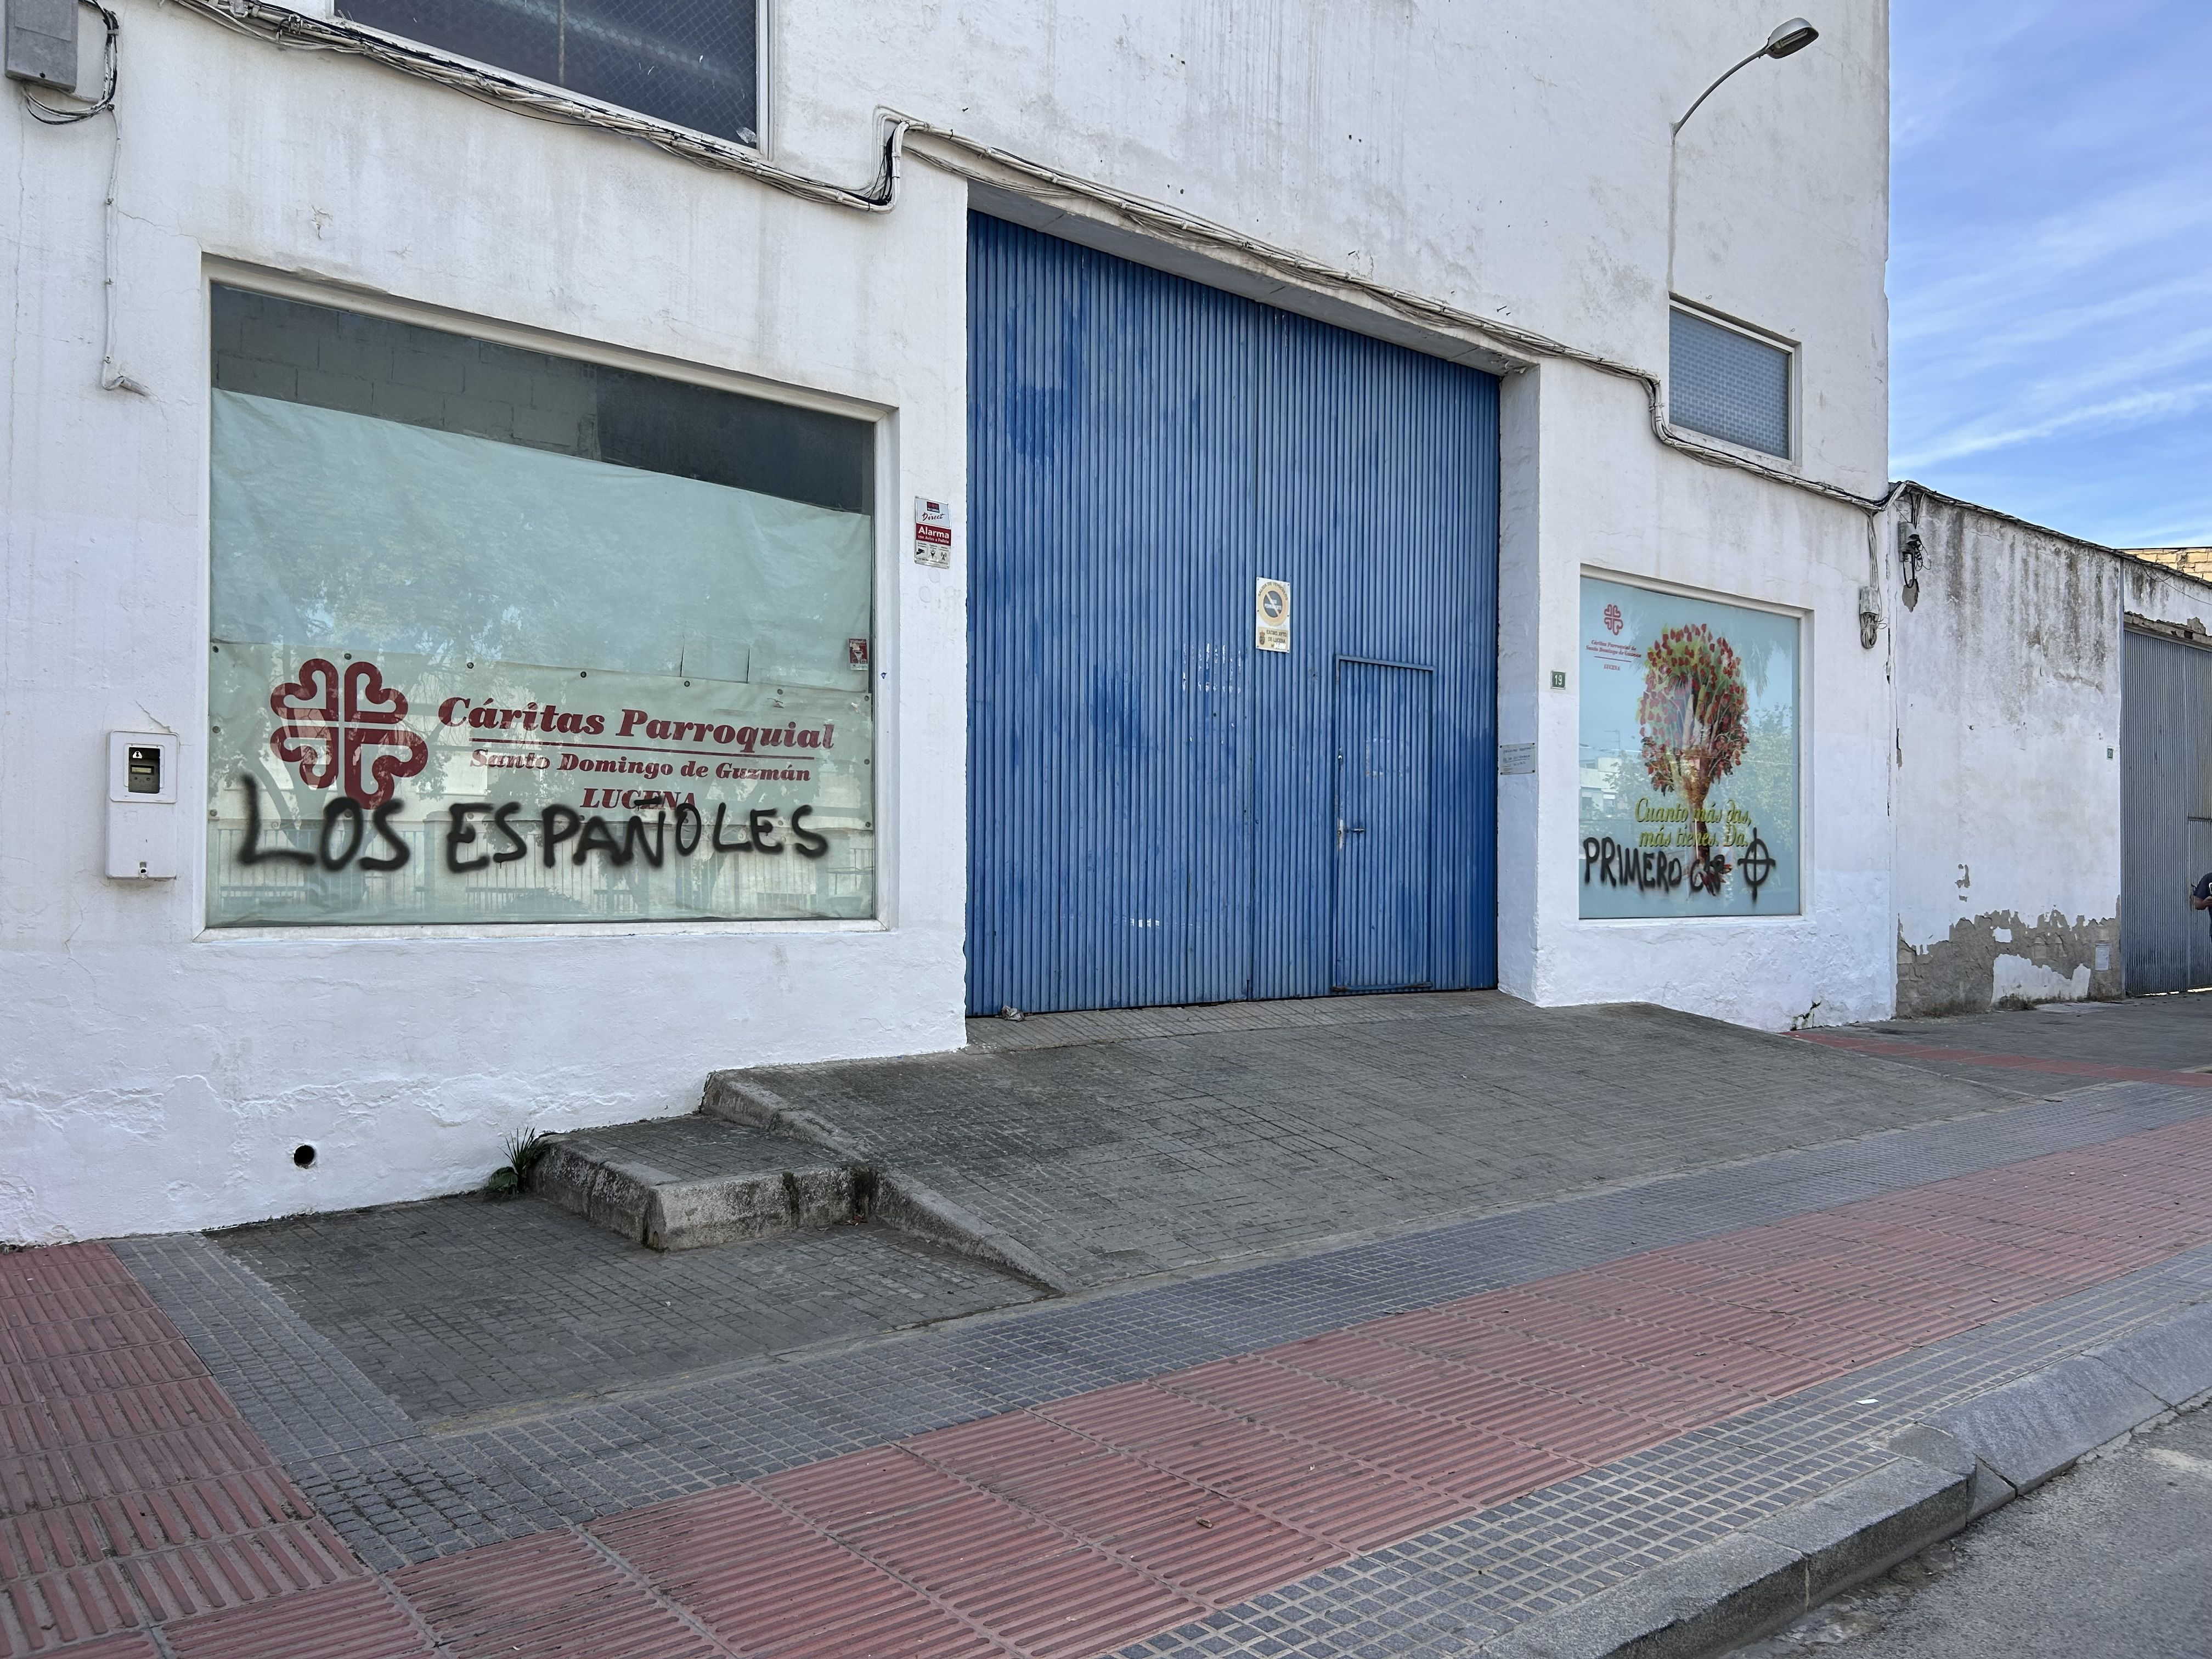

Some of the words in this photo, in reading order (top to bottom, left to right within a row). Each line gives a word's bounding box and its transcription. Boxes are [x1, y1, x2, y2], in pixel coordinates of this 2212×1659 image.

[918, 526, 950, 539] Alarma
[1554, 674, 1562, 685] 19
[438, 697, 605, 735] Cáritas
[615, 709, 835, 753] Parroquial
[470, 748, 550, 770] Santo
[556, 753, 674, 780] Domingo
[680, 760, 709, 778] de
[715, 762, 811, 781] Guzmán
[579, 788, 696, 811] LUCENA
[1635, 797, 1689, 823] Cuanto
[1692, 802, 1723, 823] más
[1726, 799, 1752, 827] das,
[236, 772, 410, 872] LOS
[447, 795, 830, 873] ESPAÑOLES
[1639, 825, 1672, 848] más
[1675, 824, 1719, 848] tienes.
[1723, 822, 1748, 848] Da.
[1582, 836, 1683, 894] PRIMERO
